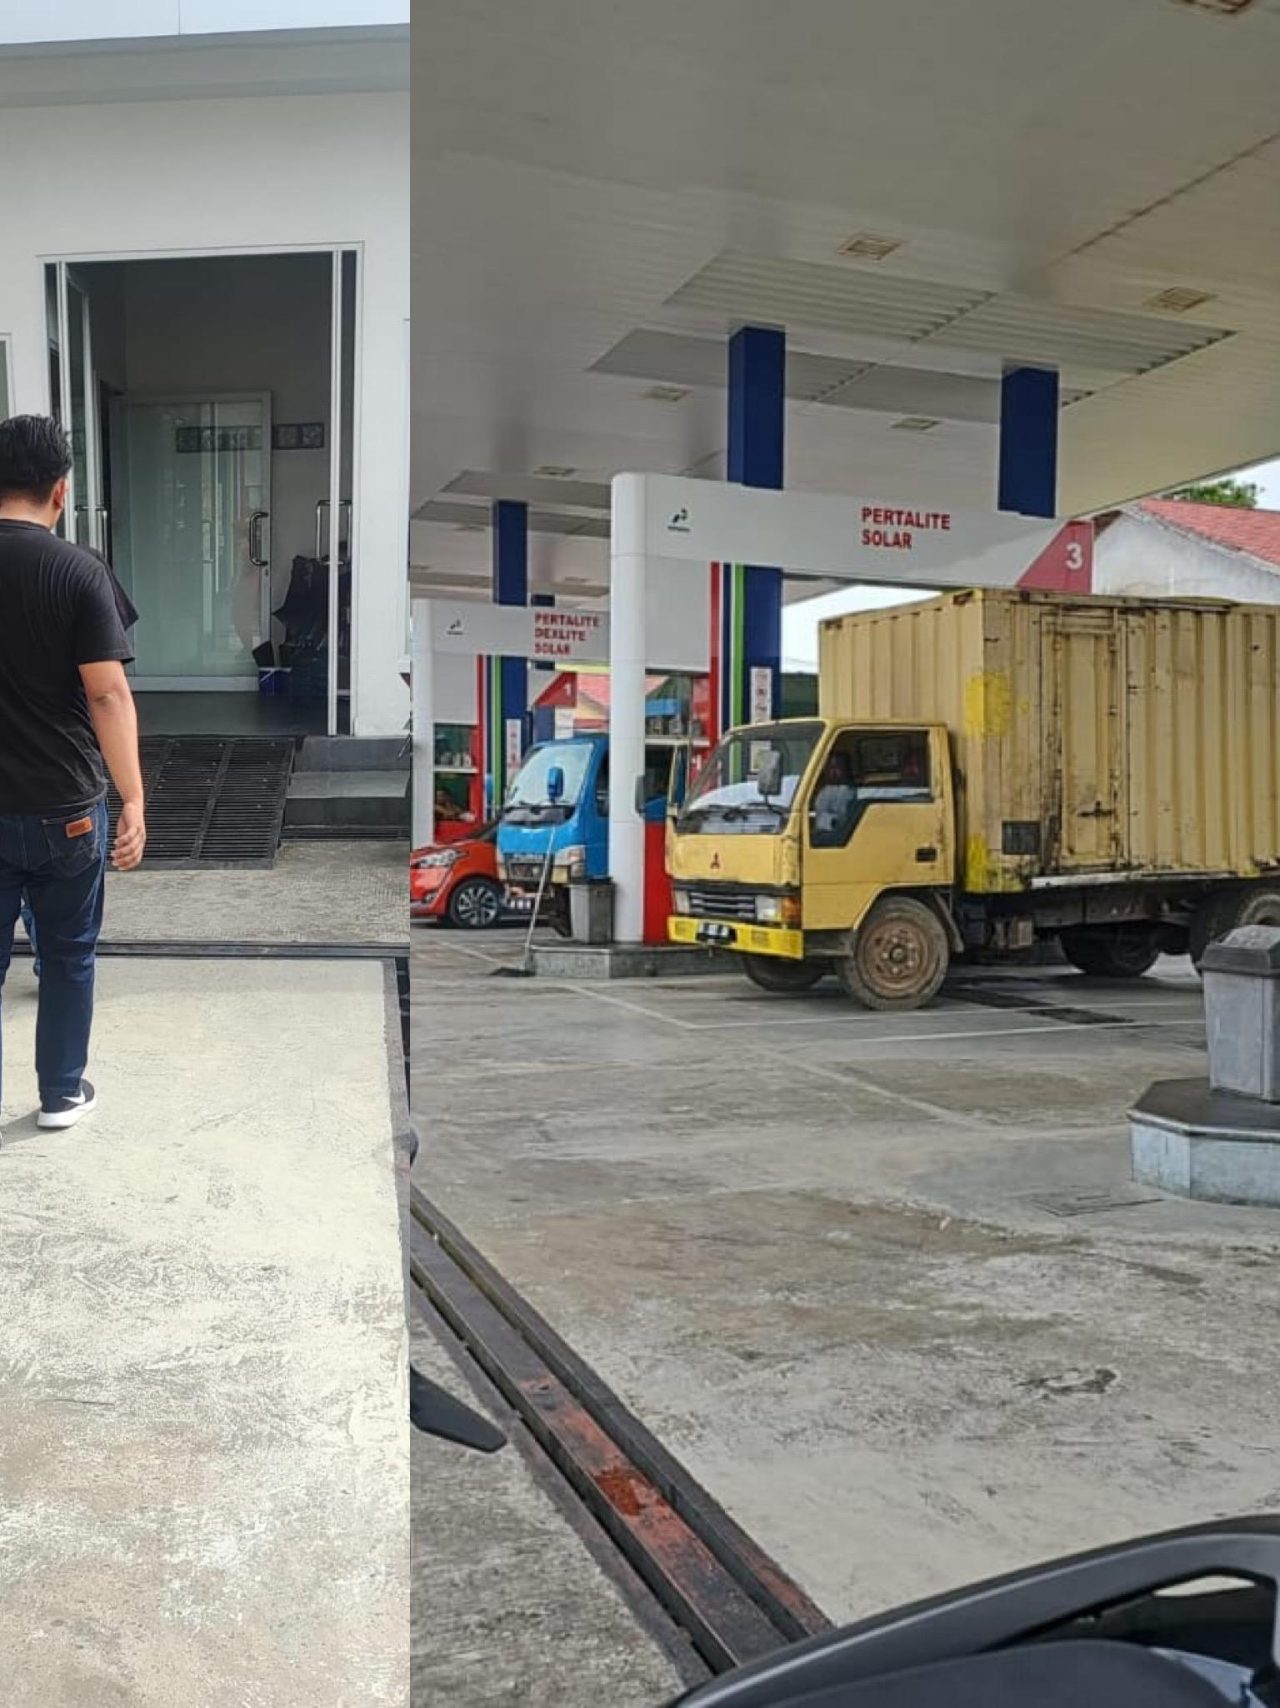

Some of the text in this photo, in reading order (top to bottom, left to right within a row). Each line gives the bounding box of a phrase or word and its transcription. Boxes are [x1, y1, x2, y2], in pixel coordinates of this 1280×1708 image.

[862, 506, 951, 530] PERTALITE
[862, 529, 912, 549] SOLAR
[1066, 542, 1083, 570] 3
[534, 612, 599, 628] PERTALITE
